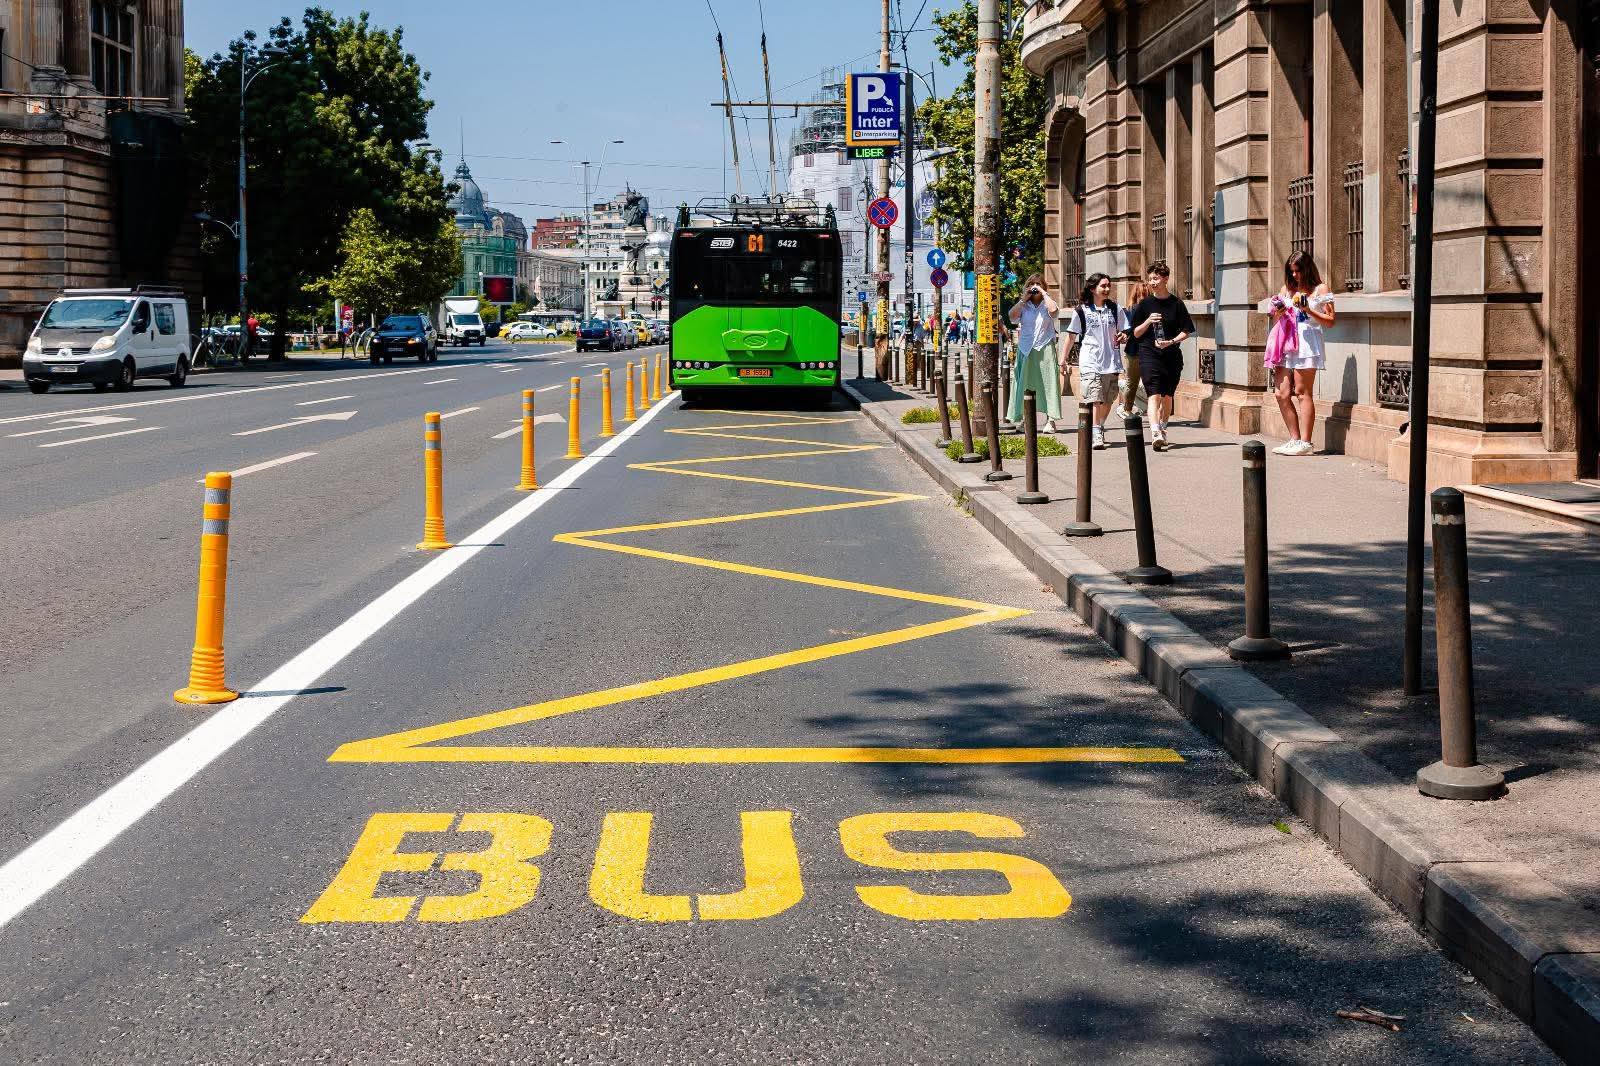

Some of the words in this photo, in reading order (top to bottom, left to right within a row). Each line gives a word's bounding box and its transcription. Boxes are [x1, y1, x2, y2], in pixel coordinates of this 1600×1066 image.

[857, 77, 886, 113] P
[857, 115, 893, 128] Inter
[855, 148, 884, 158] LIBER
[748, 234, 764, 252] 61
[777, 239, 798, 248] 5422
[298, 810, 1073, 923] BUS
